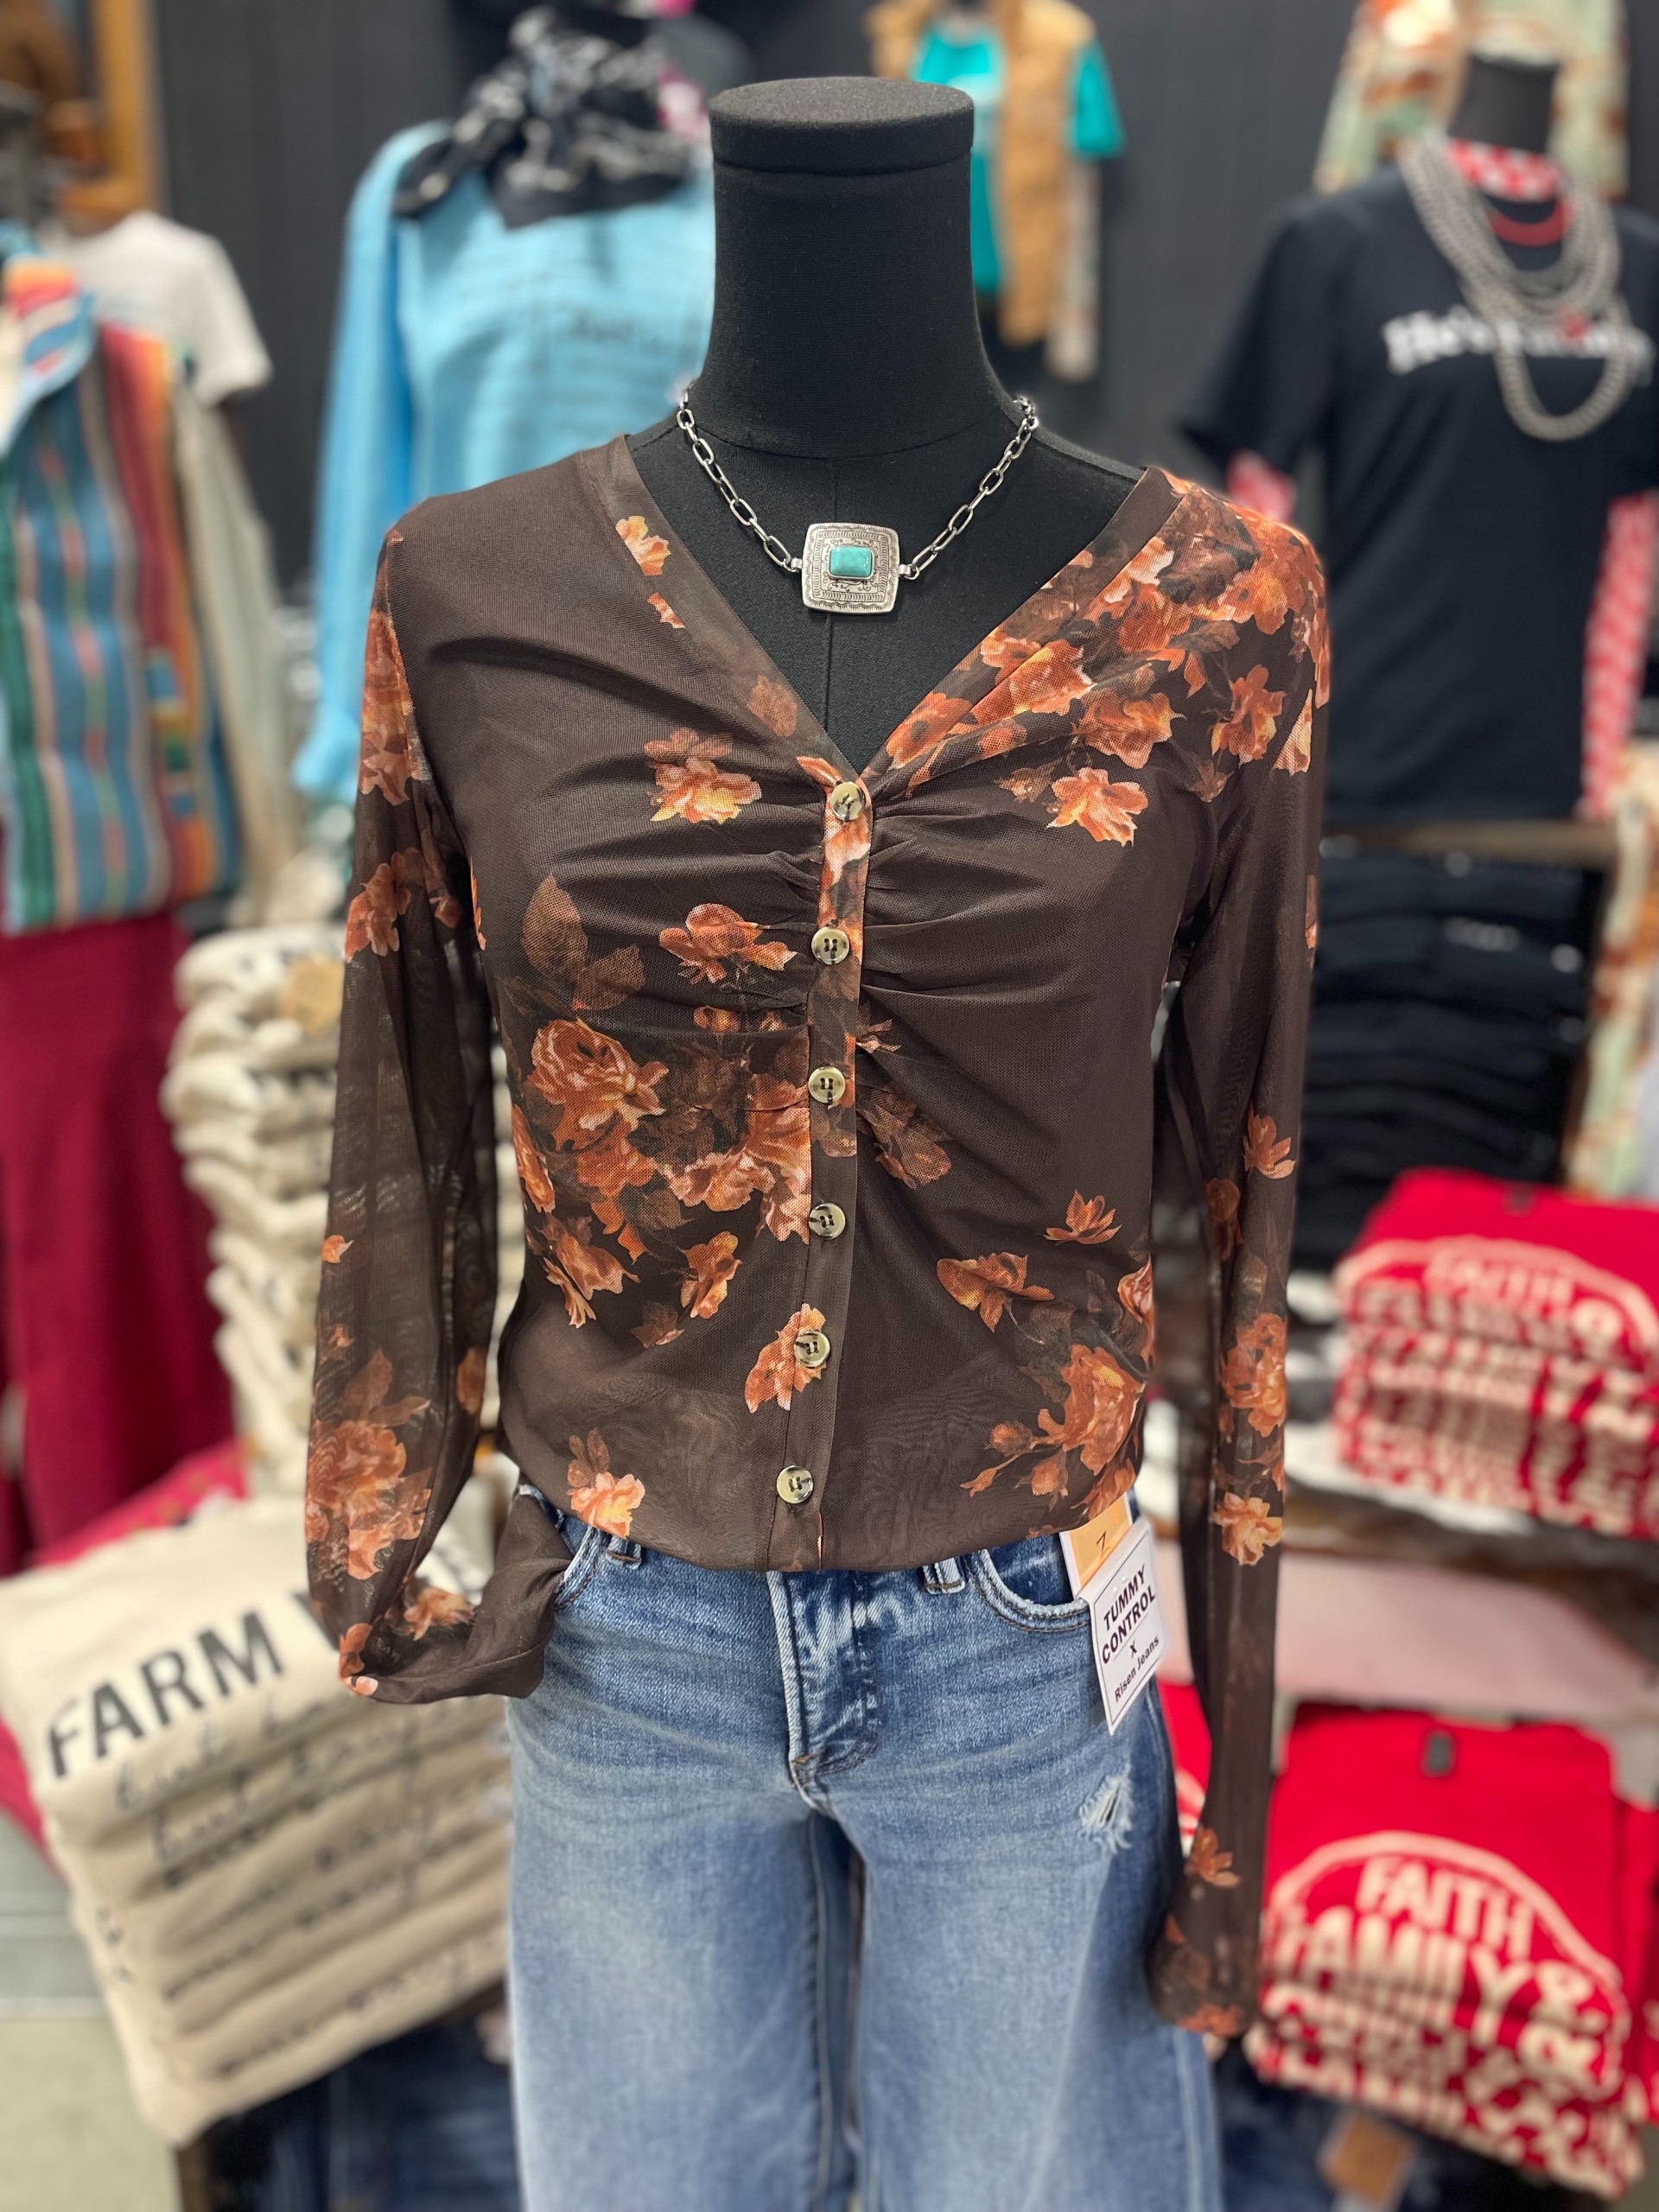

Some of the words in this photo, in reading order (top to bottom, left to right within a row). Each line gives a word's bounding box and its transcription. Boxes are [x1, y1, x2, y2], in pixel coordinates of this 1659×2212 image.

[1103, 1565, 1145, 1630] TUMMY
[1103, 1586, 1155, 1664] CONTROL
[47, 1610, 283, 1780] FARM
[1115, 1669, 1137, 1702] Risen
[1137, 1636, 1160, 1669] Jeans
[1356, 1857, 1535, 1963] FAITH
